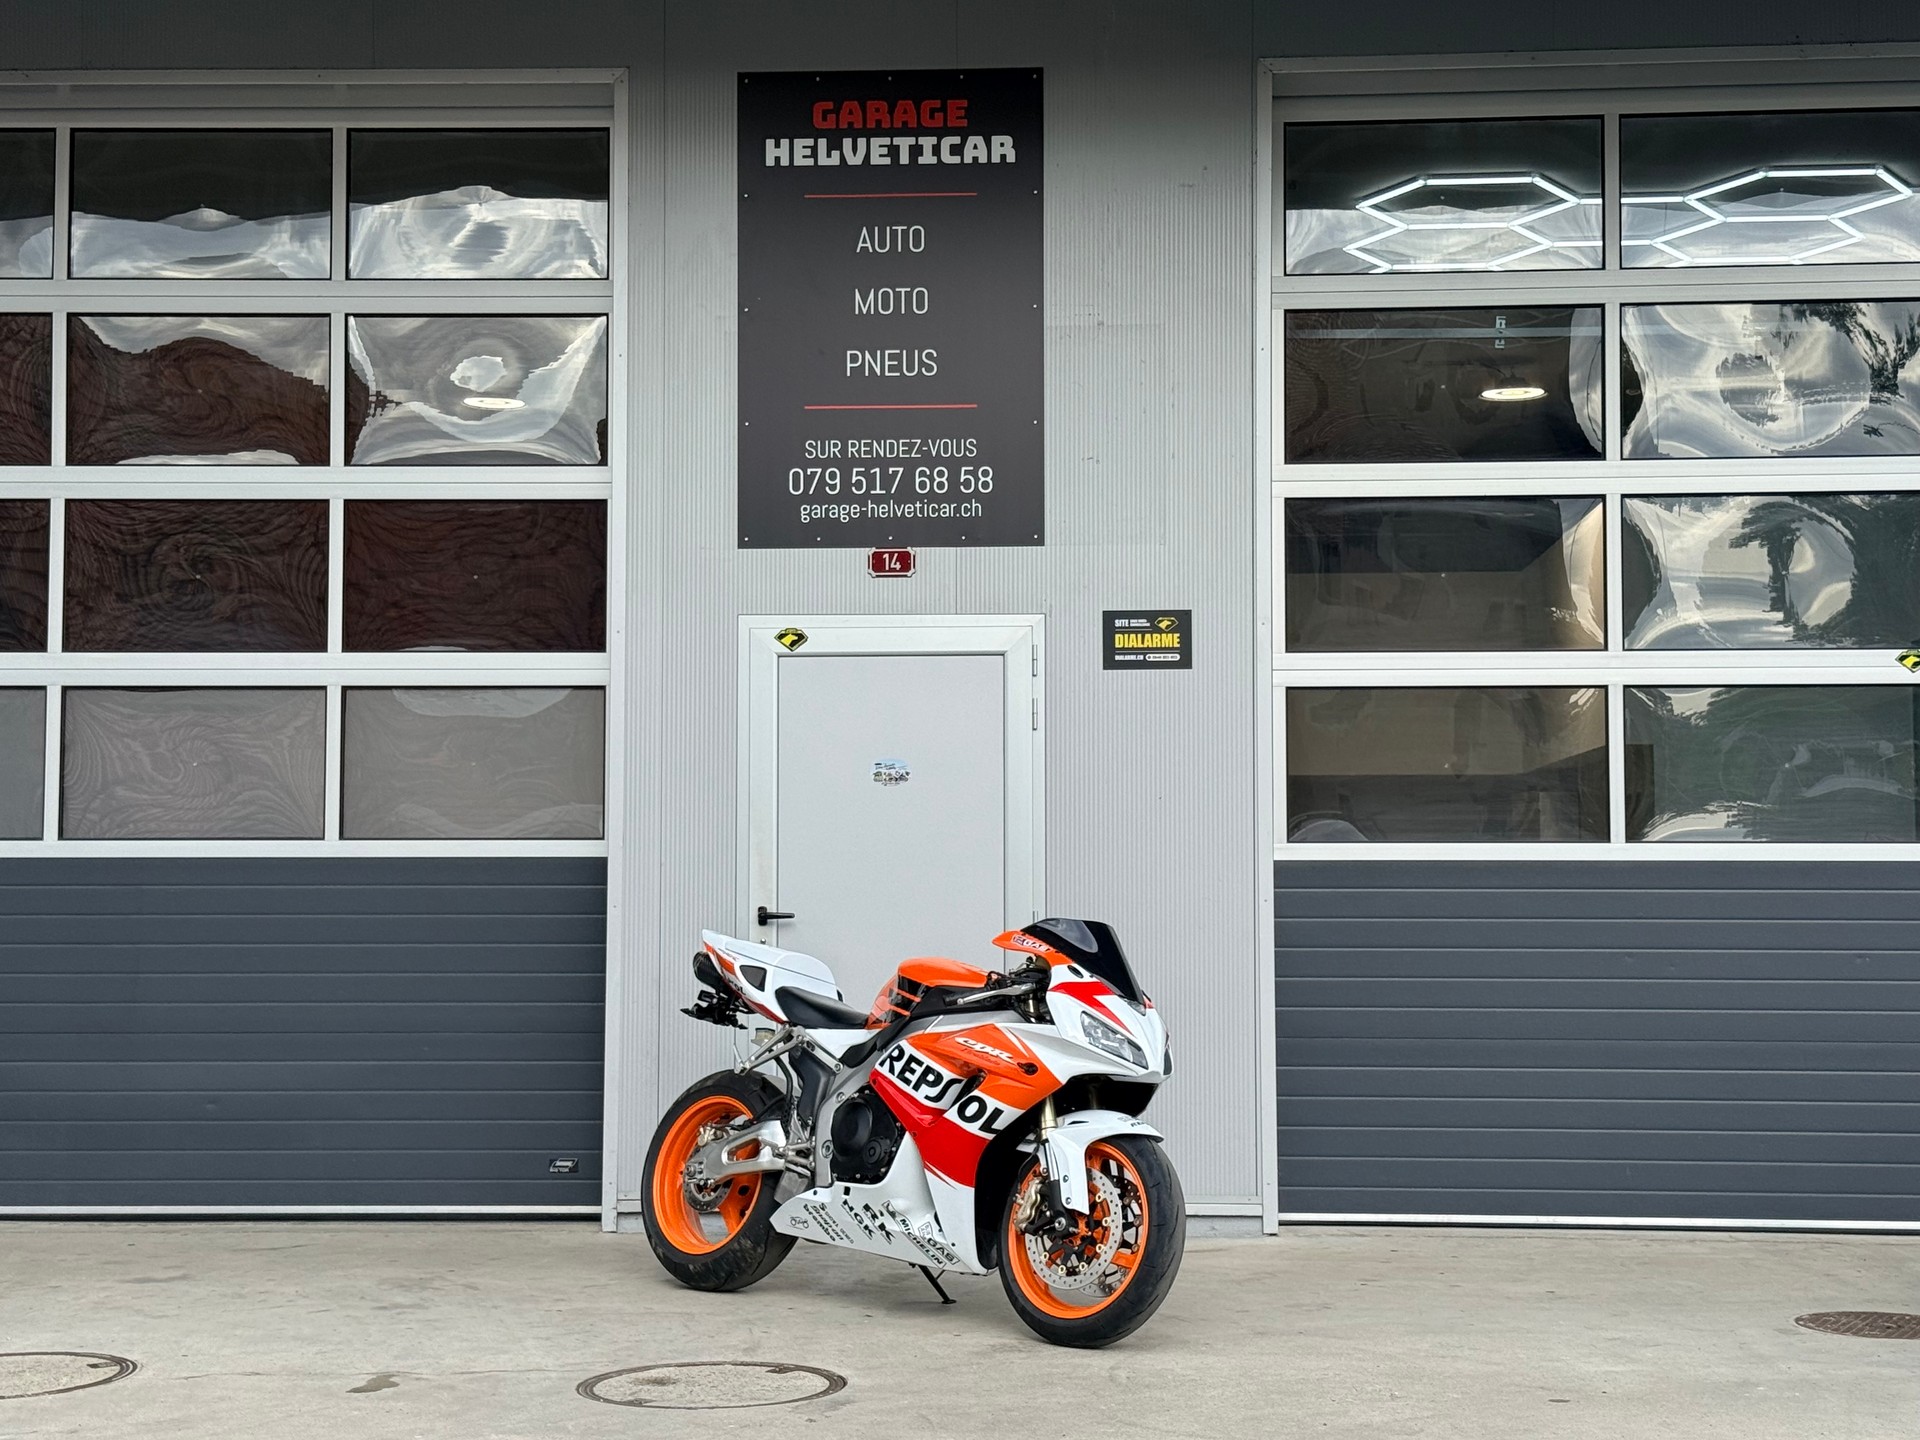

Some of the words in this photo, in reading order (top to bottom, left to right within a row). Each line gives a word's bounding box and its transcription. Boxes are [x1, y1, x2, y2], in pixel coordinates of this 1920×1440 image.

[812, 99, 969, 129] GARAGE
[764, 135, 1017, 167] HELVETICAR
[856, 225, 926, 253] AUTO
[854, 287, 929, 315] MOTO
[845, 349, 939, 377] PNEUS
[804, 439, 842, 459] SUR
[847, 438, 978, 459] RENDEZ-VOUS
[788, 467, 841, 496] 079
[850, 467, 905, 495] 517
[914, 466, 949, 495] 68
[959, 465, 994, 494] 58
[799, 498, 983, 523] garage-helveticar.ch
[882, 552, 902, 571] 14
[1114, 619, 1129, 628] SITE
[1114, 633, 1181, 648] DIALARME
[878, 1043, 1005, 1135] REPSOL
[842, 1198, 877, 1239] NGK
[900, 1218, 943, 1265] MICHELIN
